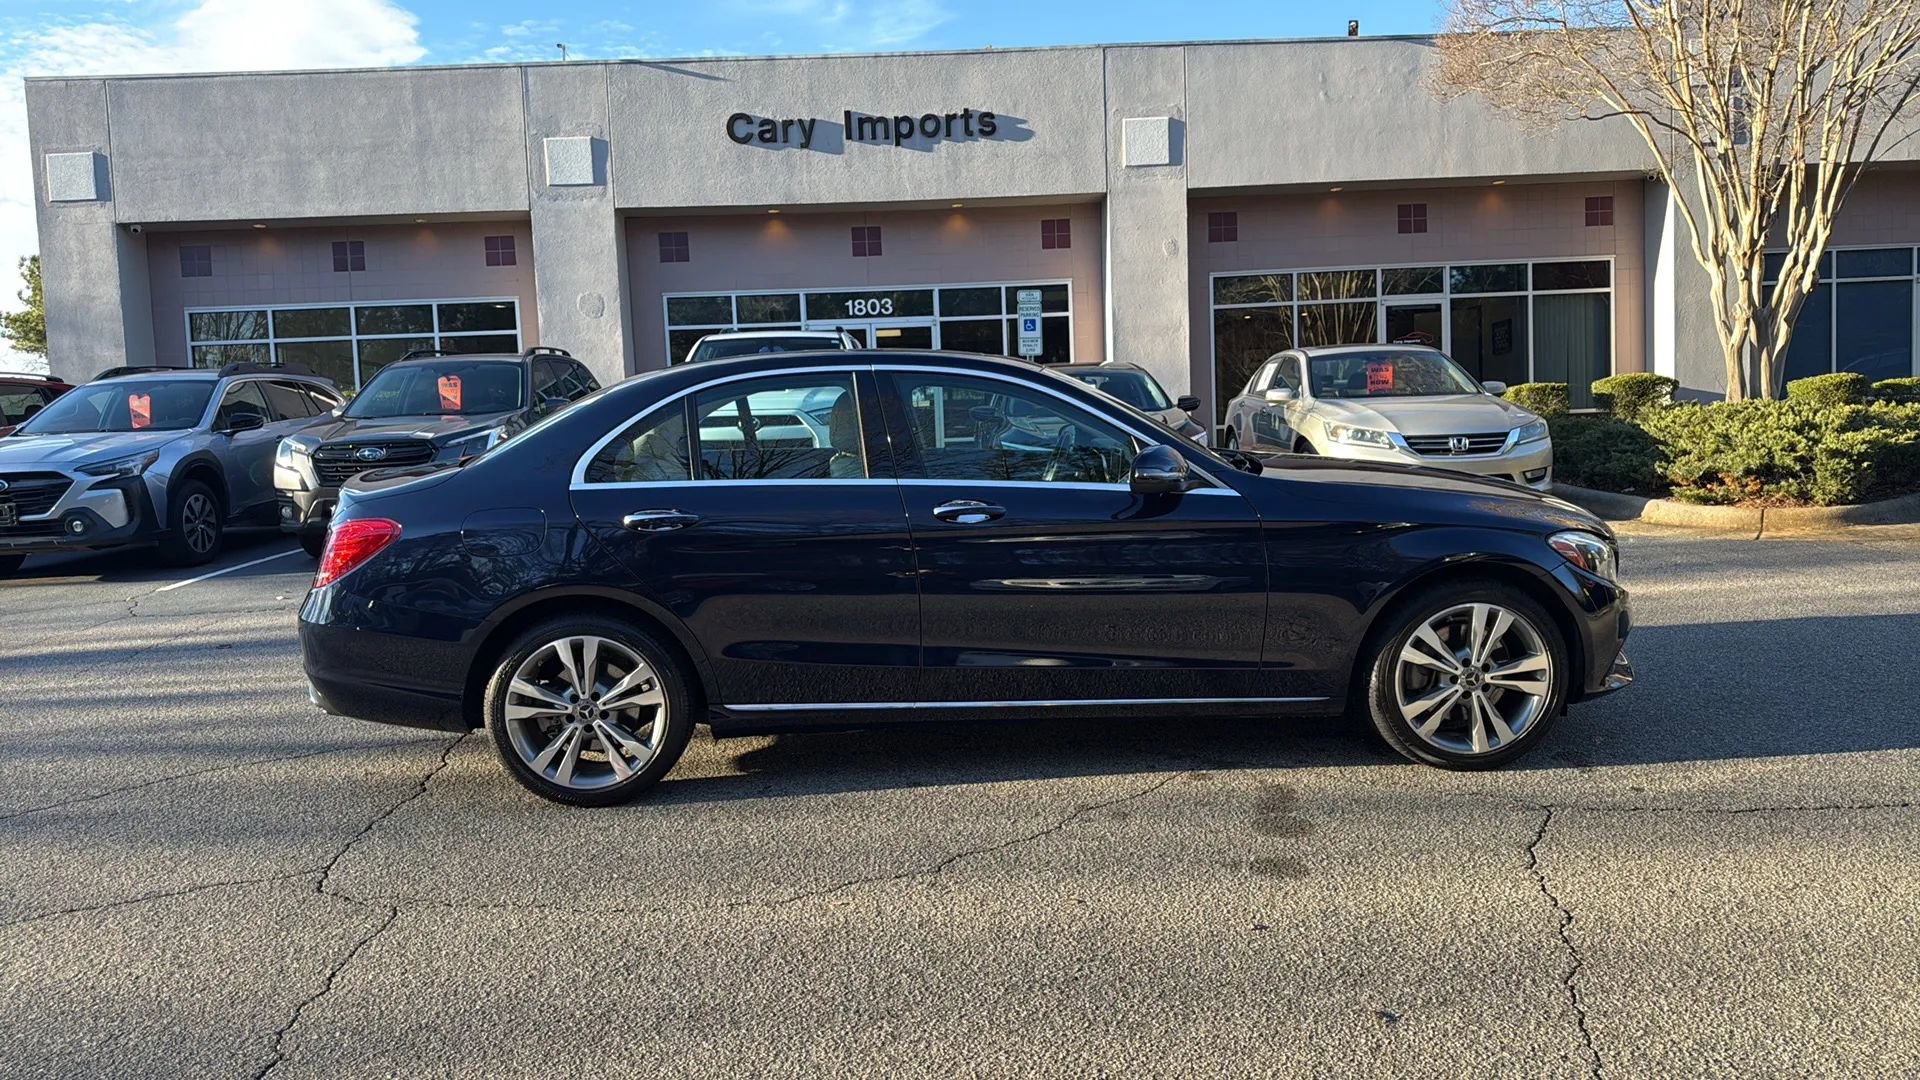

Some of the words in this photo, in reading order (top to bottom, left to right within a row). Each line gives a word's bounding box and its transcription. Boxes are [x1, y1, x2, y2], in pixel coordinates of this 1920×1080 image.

[726, 112, 816, 148] Cary
[844, 108, 997, 147] Imports
[845, 298, 893, 316] 1803
